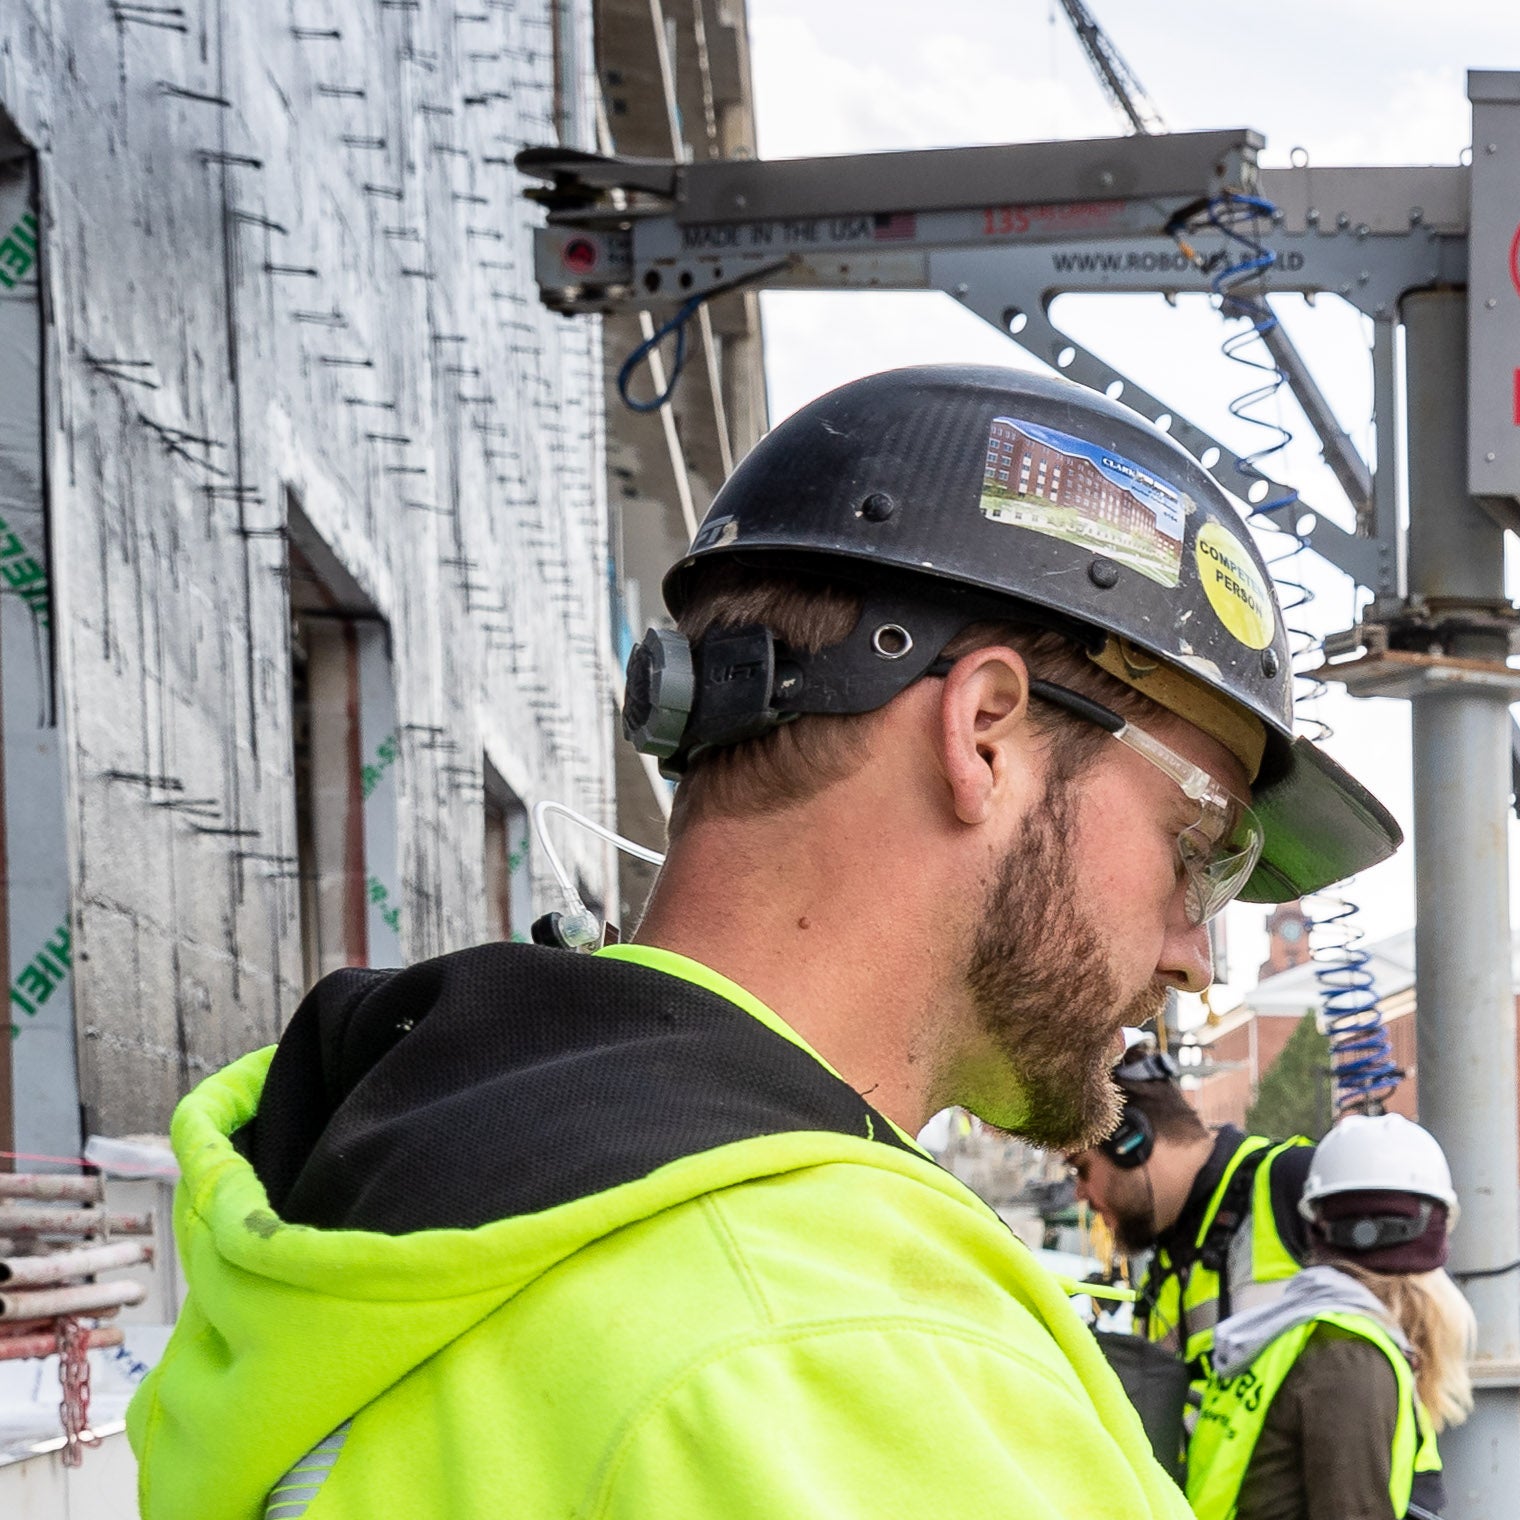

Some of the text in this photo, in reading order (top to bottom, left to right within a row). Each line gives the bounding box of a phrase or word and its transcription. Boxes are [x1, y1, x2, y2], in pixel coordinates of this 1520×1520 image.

[681, 217, 872, 248] MADE IN THE USA
[1102, 457, 1137, 478] CLARK
[1216, 569, 1263, 617] PERSON
